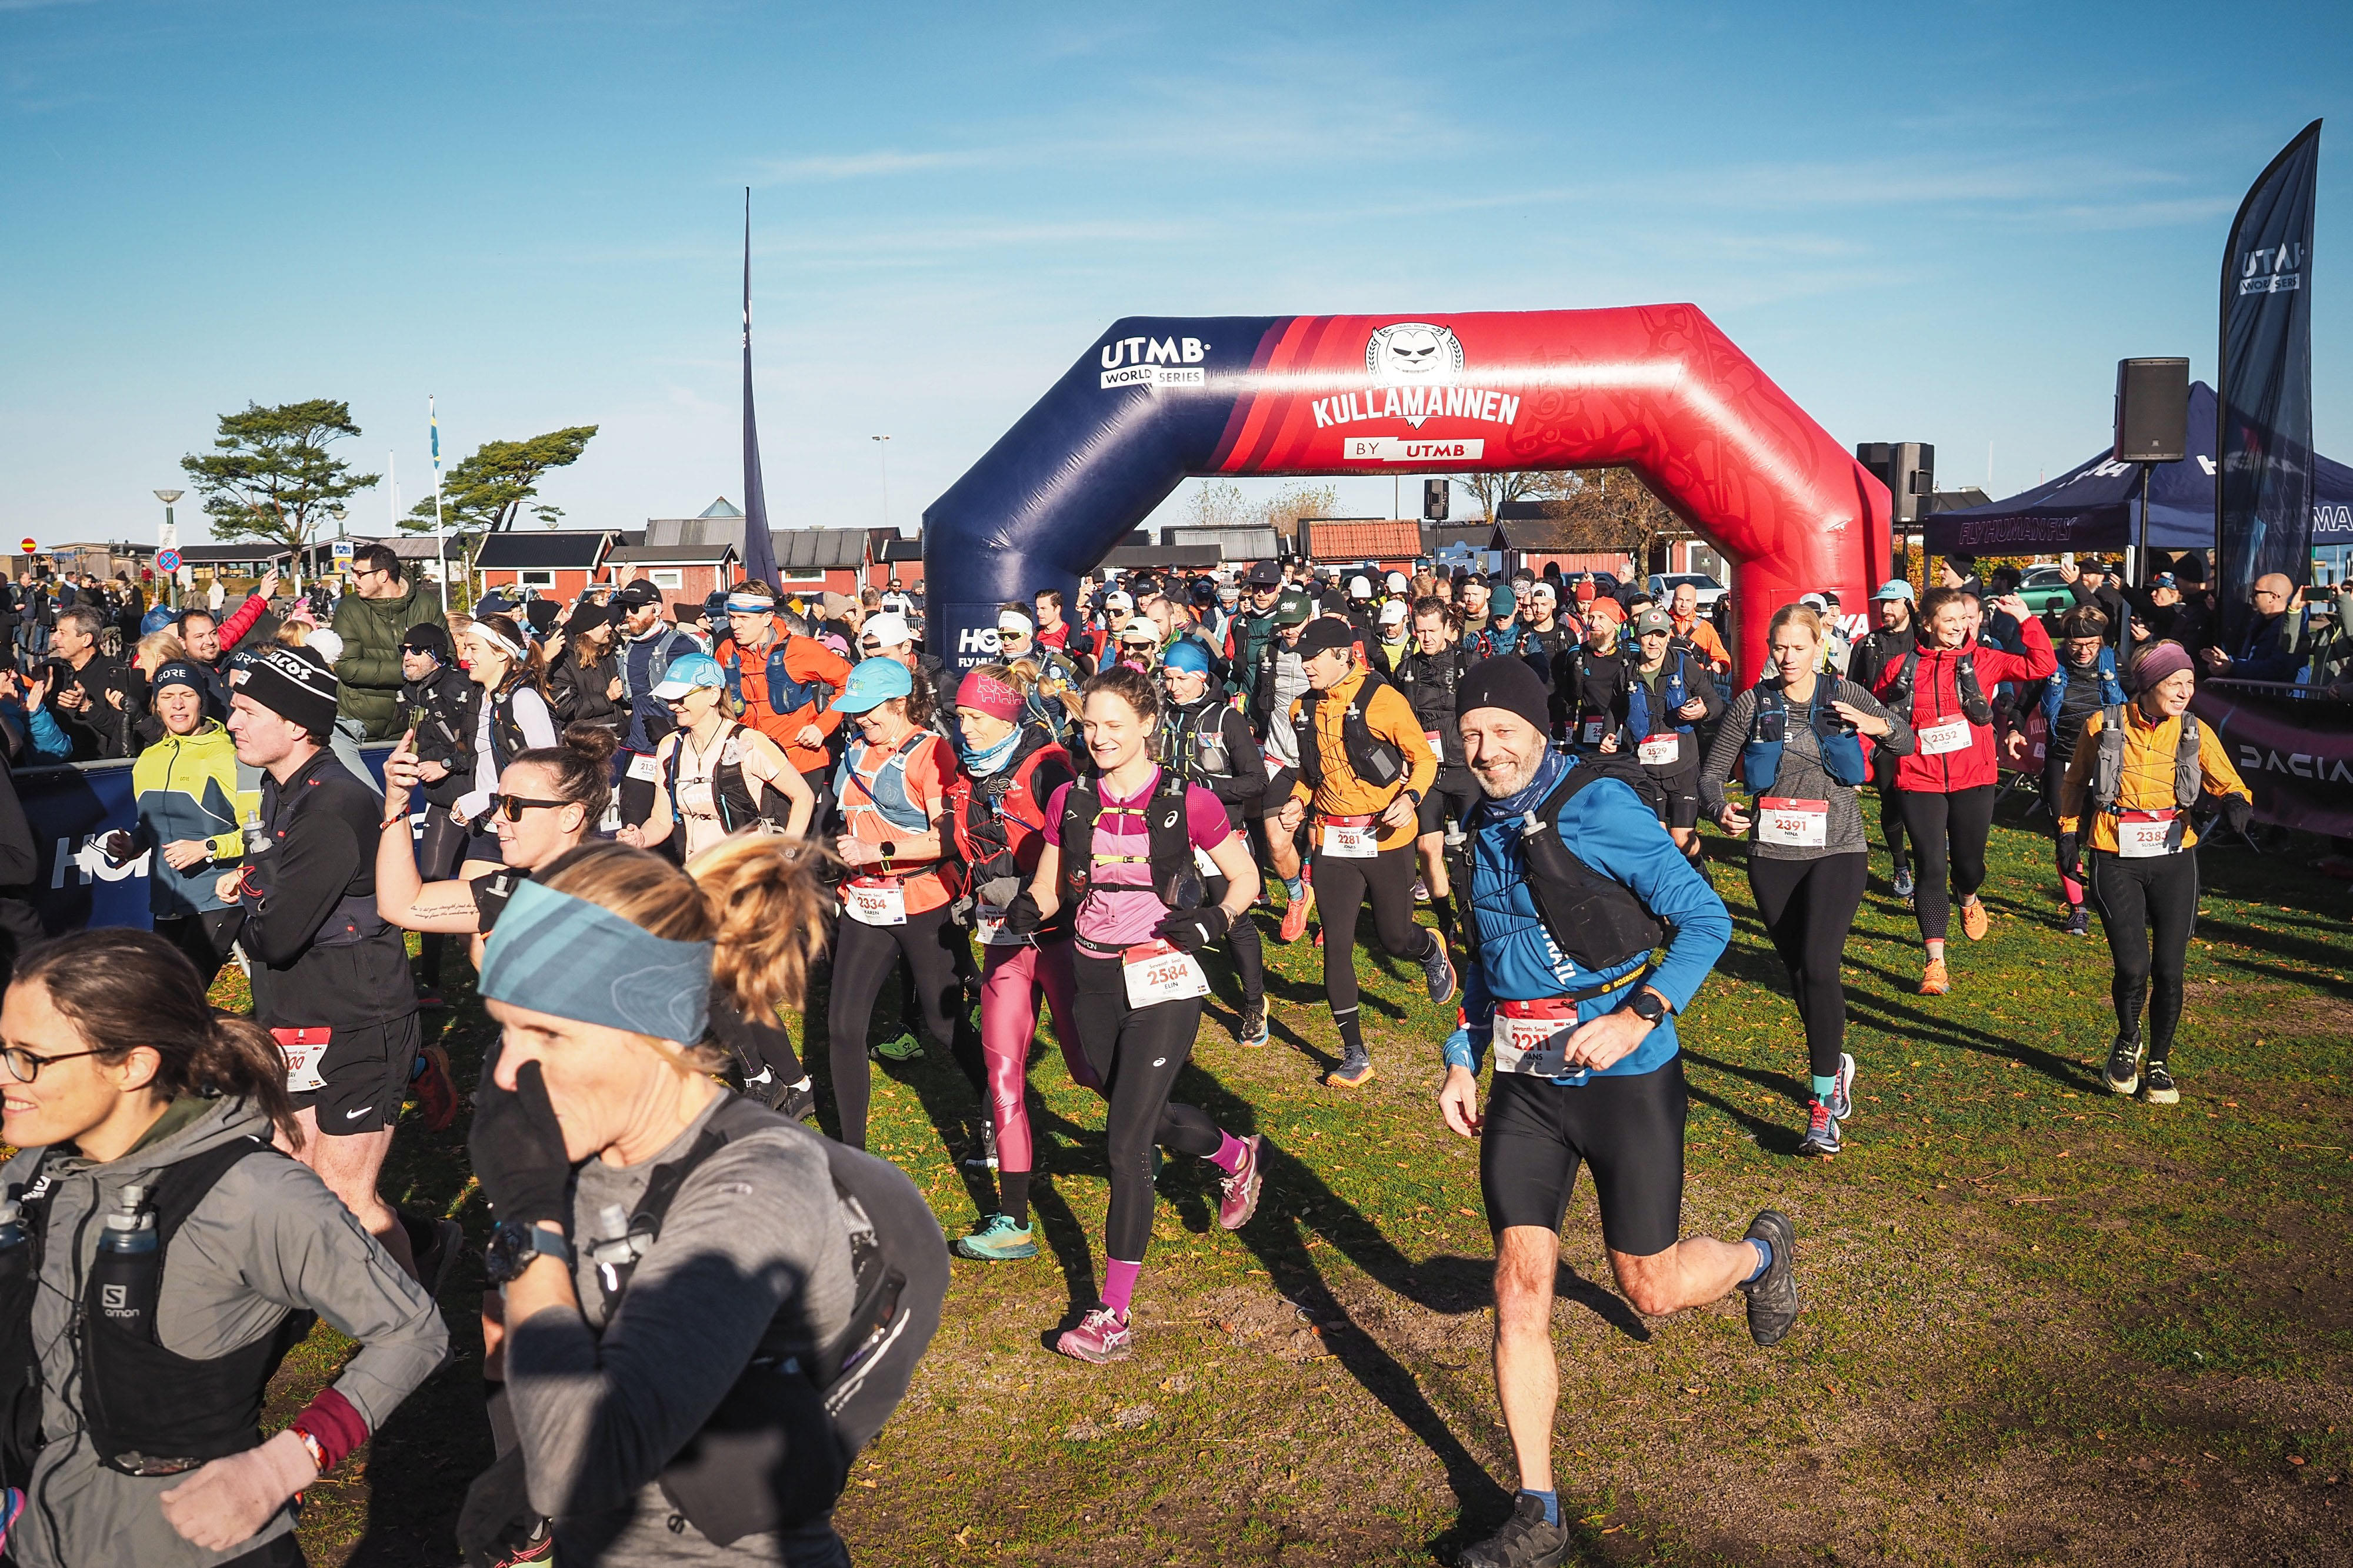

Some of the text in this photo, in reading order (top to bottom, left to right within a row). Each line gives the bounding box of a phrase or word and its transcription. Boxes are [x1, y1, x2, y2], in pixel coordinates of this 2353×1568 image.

[1102, 336, 1205, 369] UTMB
[1106, 369, 1200, 383] WORLD SERIES
[1312, 386, 1520, 428] KULLAMANNEN
[1357, 442, 1465, 457] BY UTMB
[1834, 613, 1869, 638] KA
[958, 628, 1001, 653] HO
[958, 657, 975, 667] FLY
[158, 669, 186, 683] GORE
[1931, 730, 1958, 742] 2352
[1647, 747, 1667, 755] 2529
[2239, 745, 2353, 783] DACIA
[1775, 819, 1807, 831] 2391
[1338, 834, 1360, 844] 2281
[2136, 830, 2169, 842] 2383
[51, 829, 152, 889] HO
[857, 897, 886, 909] 2334
[1147, 963, 1188, 986] 2584
[1512, 1032, 1551, 1051] 2211
